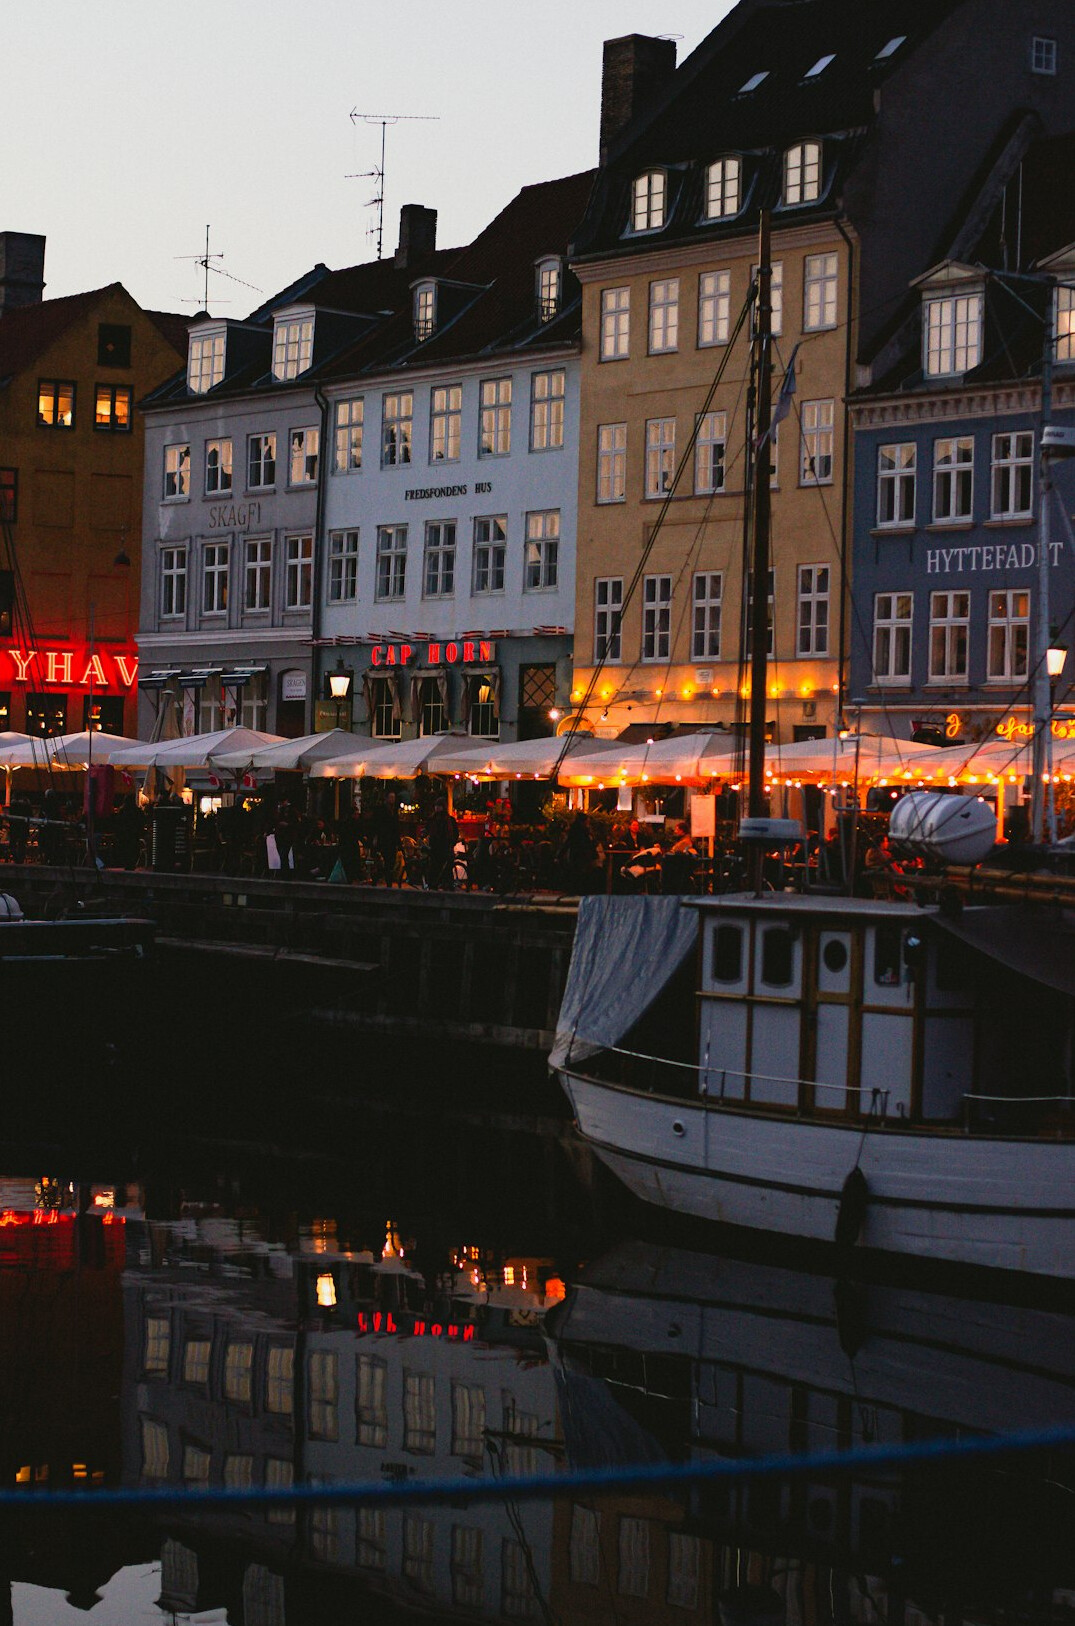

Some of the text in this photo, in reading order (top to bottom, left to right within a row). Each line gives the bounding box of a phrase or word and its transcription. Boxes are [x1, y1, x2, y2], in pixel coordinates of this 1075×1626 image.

[405, 481, 493, 500] FREDSFONDENS HUS
[926, 541, 1064, 573] HYTTEFADT
[371, 640, 492, 666] CAP HORN
